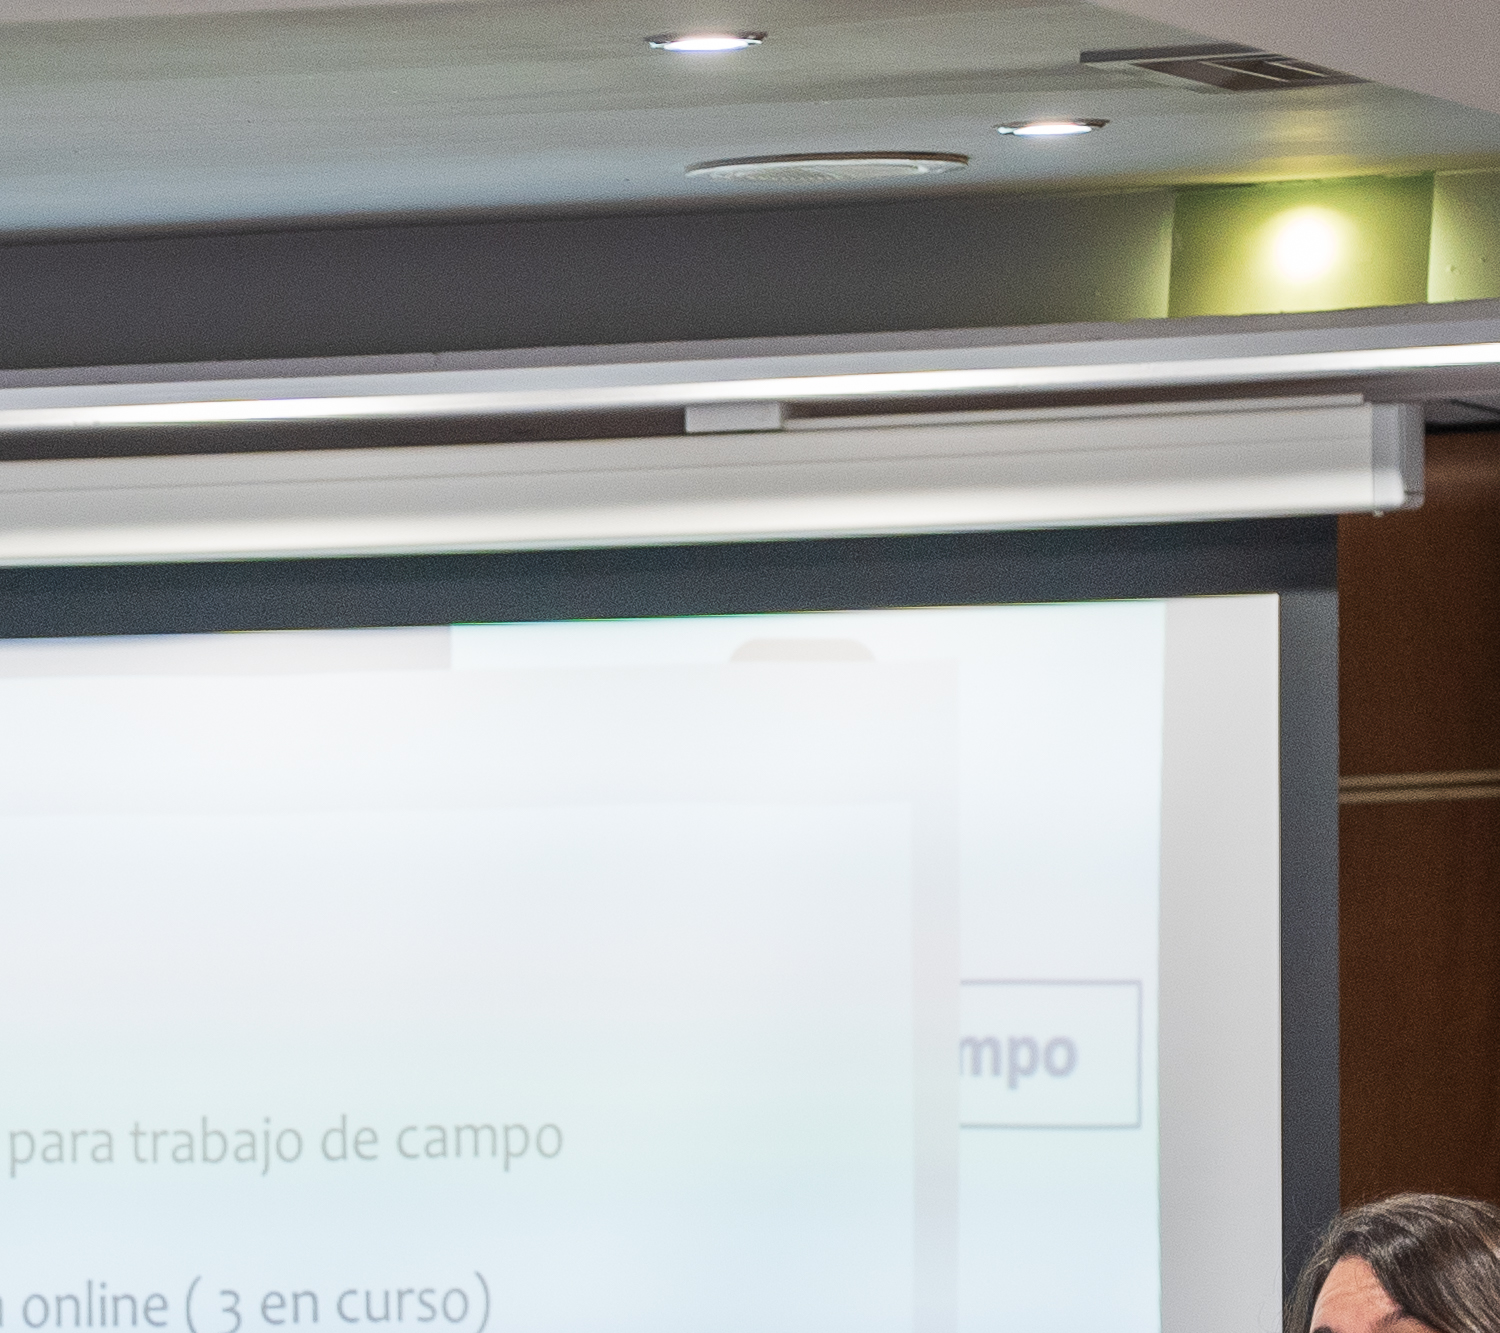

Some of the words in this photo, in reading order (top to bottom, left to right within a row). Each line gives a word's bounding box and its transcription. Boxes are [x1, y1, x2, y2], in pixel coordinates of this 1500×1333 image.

[8, 1128, 115, 1180] para
[129, 1114, 305, 1178] trabajo
[319, 1113, 380, 1163] de
[395, 1122, 564, 1174] campo
[21, 1278, 170, 1330] online
[259, 1289, 320, 1327] en
